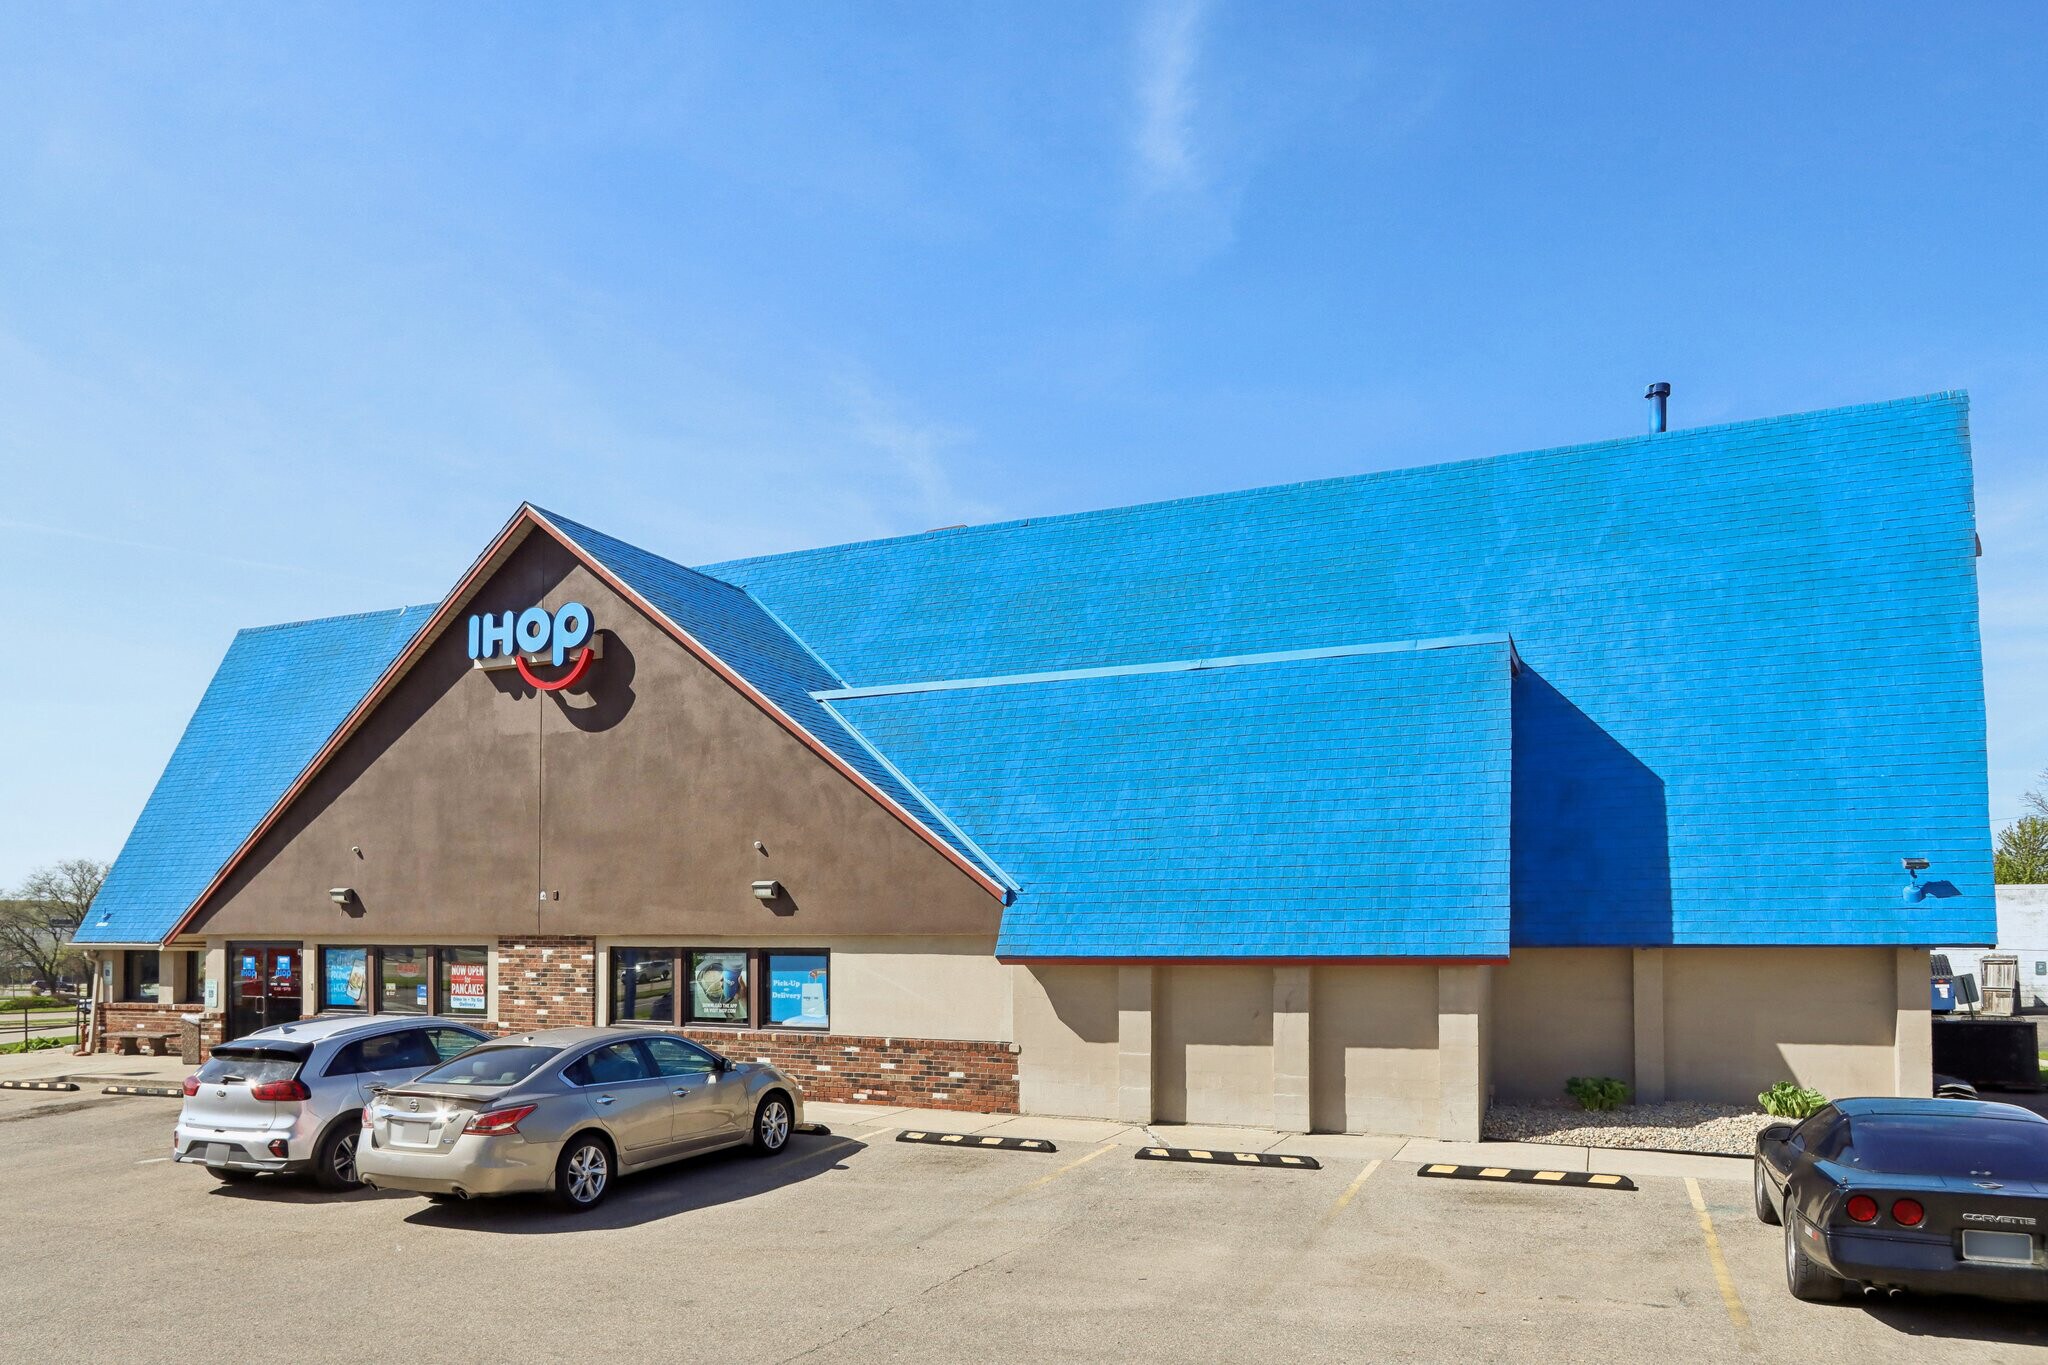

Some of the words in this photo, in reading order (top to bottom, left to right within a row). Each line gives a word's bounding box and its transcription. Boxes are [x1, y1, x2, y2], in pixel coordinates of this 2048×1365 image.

[468, 602, 594, 667] IHOP
[451, 965, 466, 976] NOW
[467, 965, 484, 977] OPEN
[464, 976, 472, 984] for
[773, 979, 800, 988] Pick-Up
[451, 983, 484, 995] PANCAKES
[772, 992, 801, 1000] Delivery
[1962, 1213, 2036, 1225] CORVETTE
